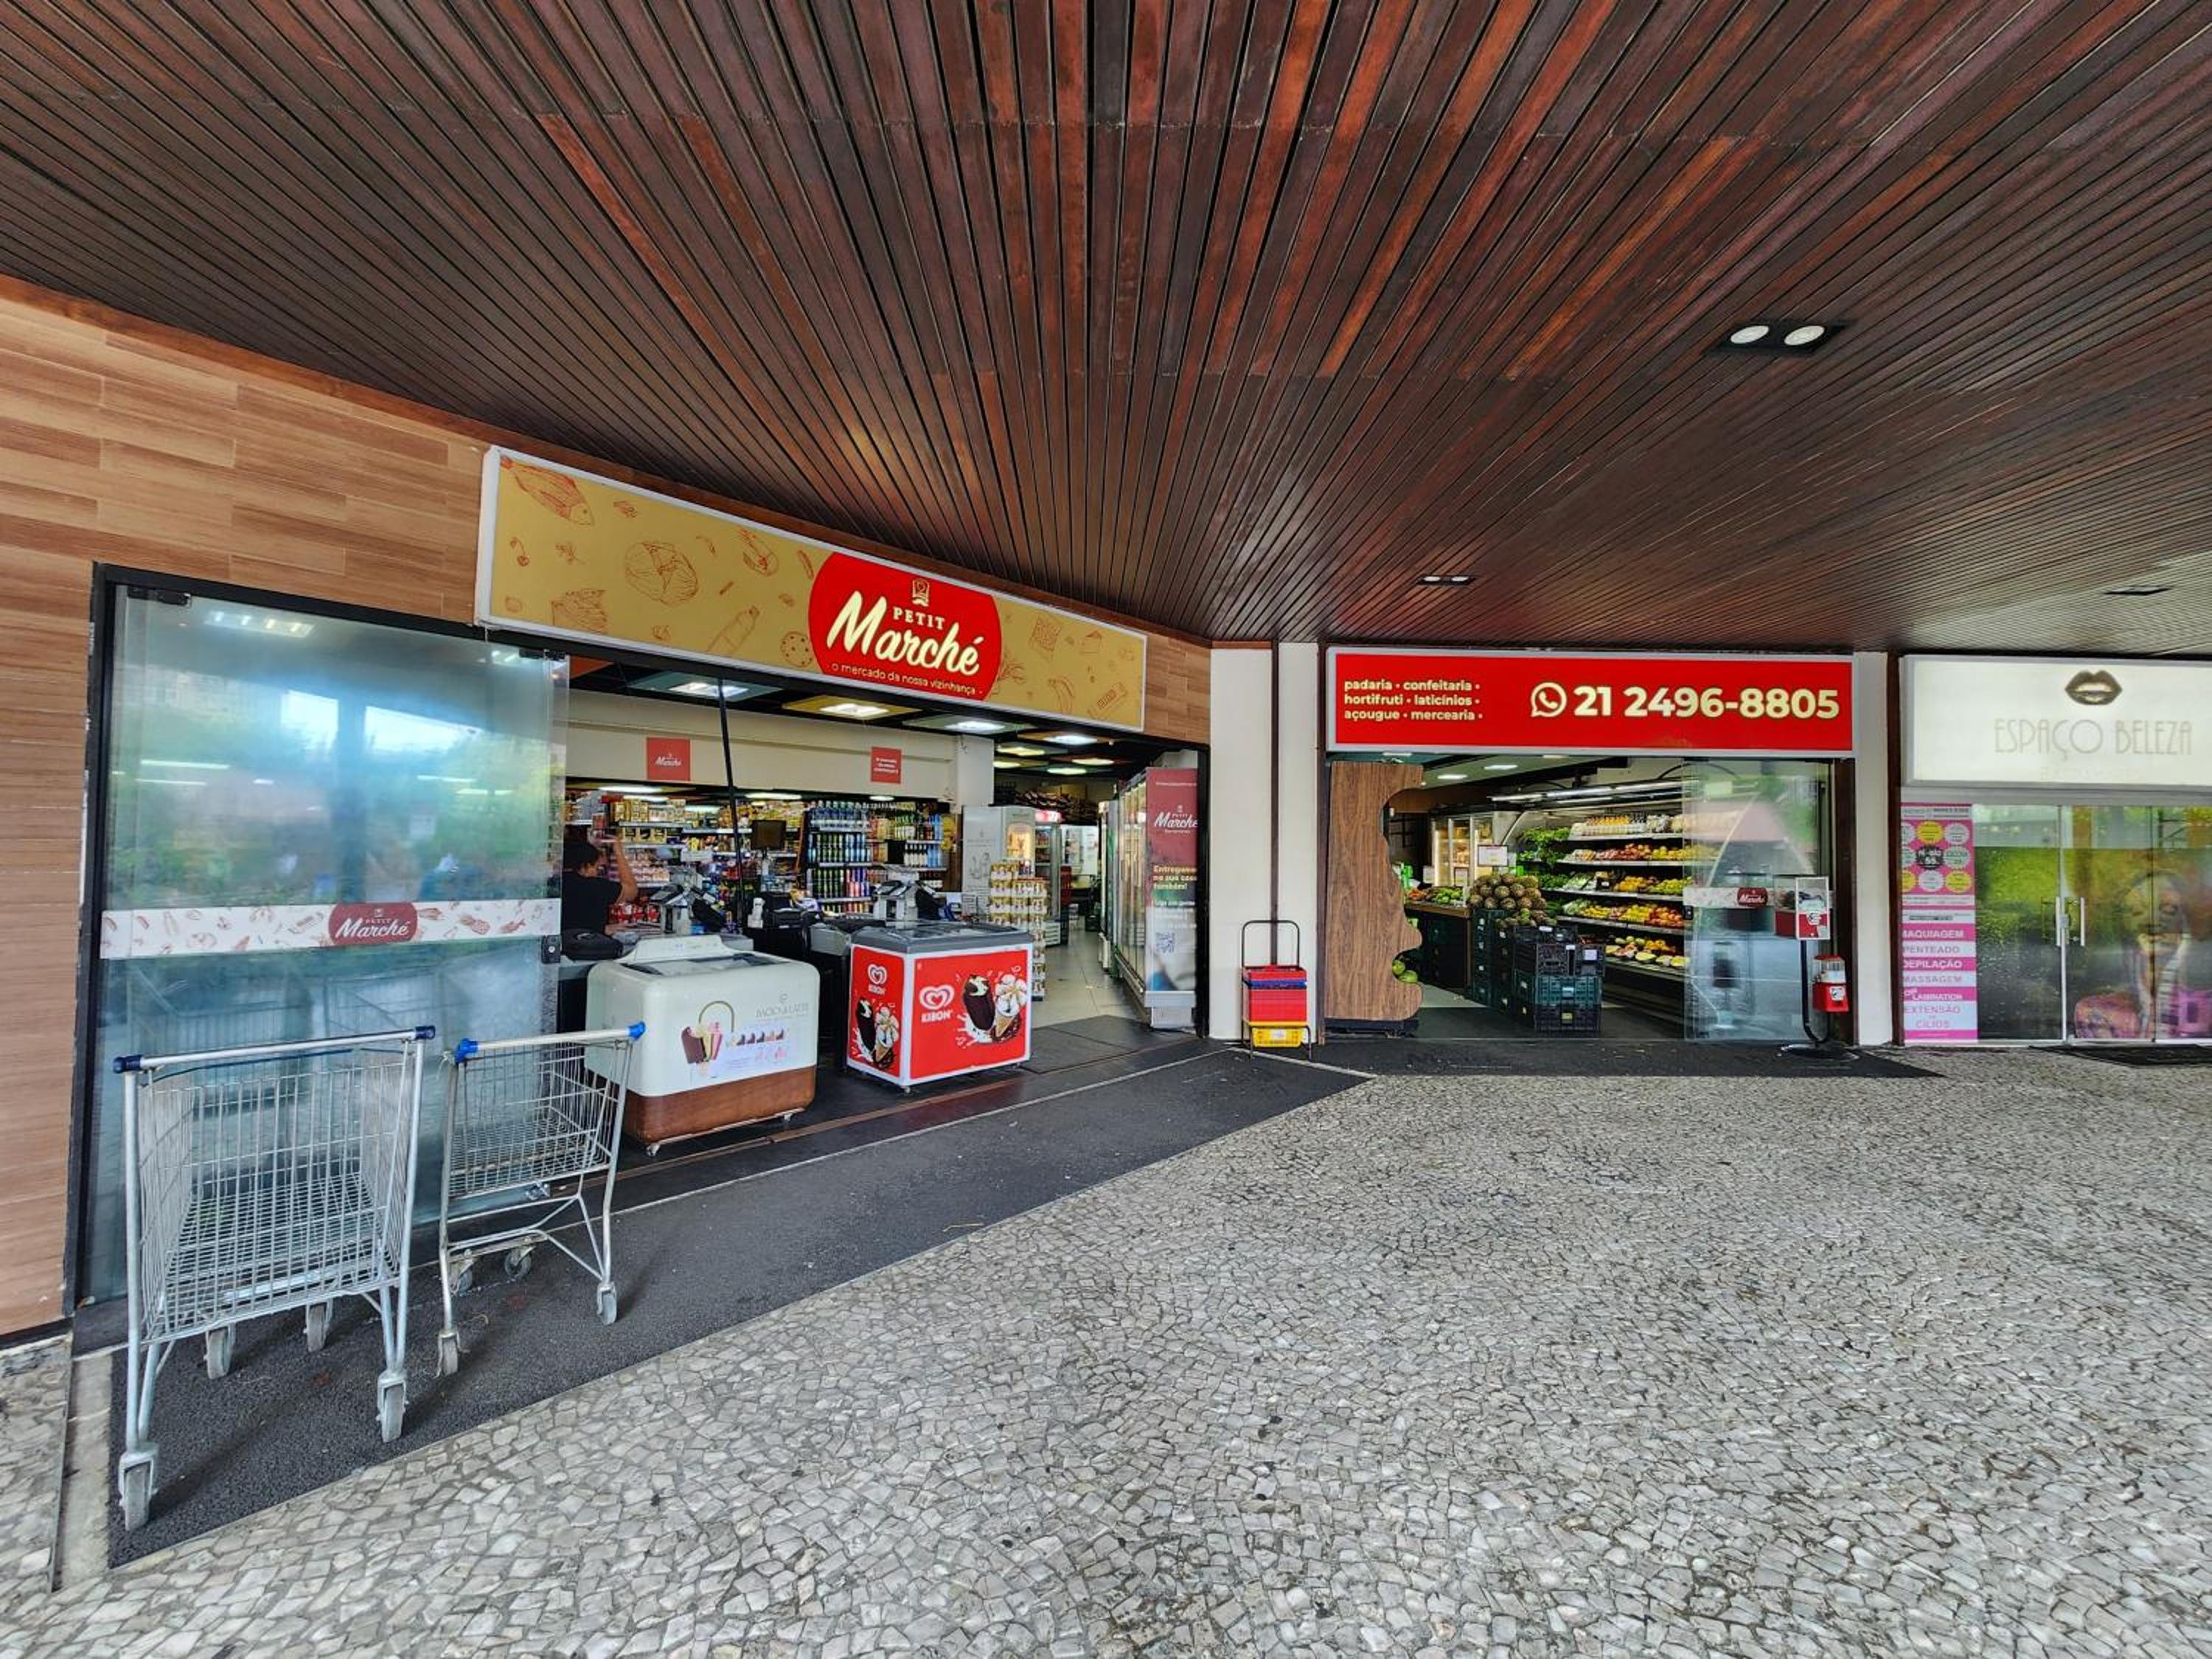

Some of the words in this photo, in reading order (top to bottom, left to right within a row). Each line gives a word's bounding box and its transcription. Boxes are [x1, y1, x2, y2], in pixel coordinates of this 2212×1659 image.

[893, 606, 945, 630] PETIT
[827, 590, 984, 675] Marché
[841, 665, 886, 679] mercado
[888, 669, 900, 682] da
[902, 674, 928, 686] nossa
[931, 678, 976, 695] vizinhança
[1344, 679, 1393, 692] padaria
[1403, 679, 1472, 691] confeitaria
[1344, 694, 1403, 705] hortifruti
[1414, 695, 1472, 706] laticínios
[1573, 686, 1613, 717] 21
[1623, 686, 1840, 719] 2496-8805
[1344, 709, 1400, 722] açougue
[1411, 709, 1475, 720] mercearia
[1994, 718, 2104, 762] ESPAÇO
[2115, 720, 2193, 755] BELEZA
[335, 917, 411, 939] Marché
